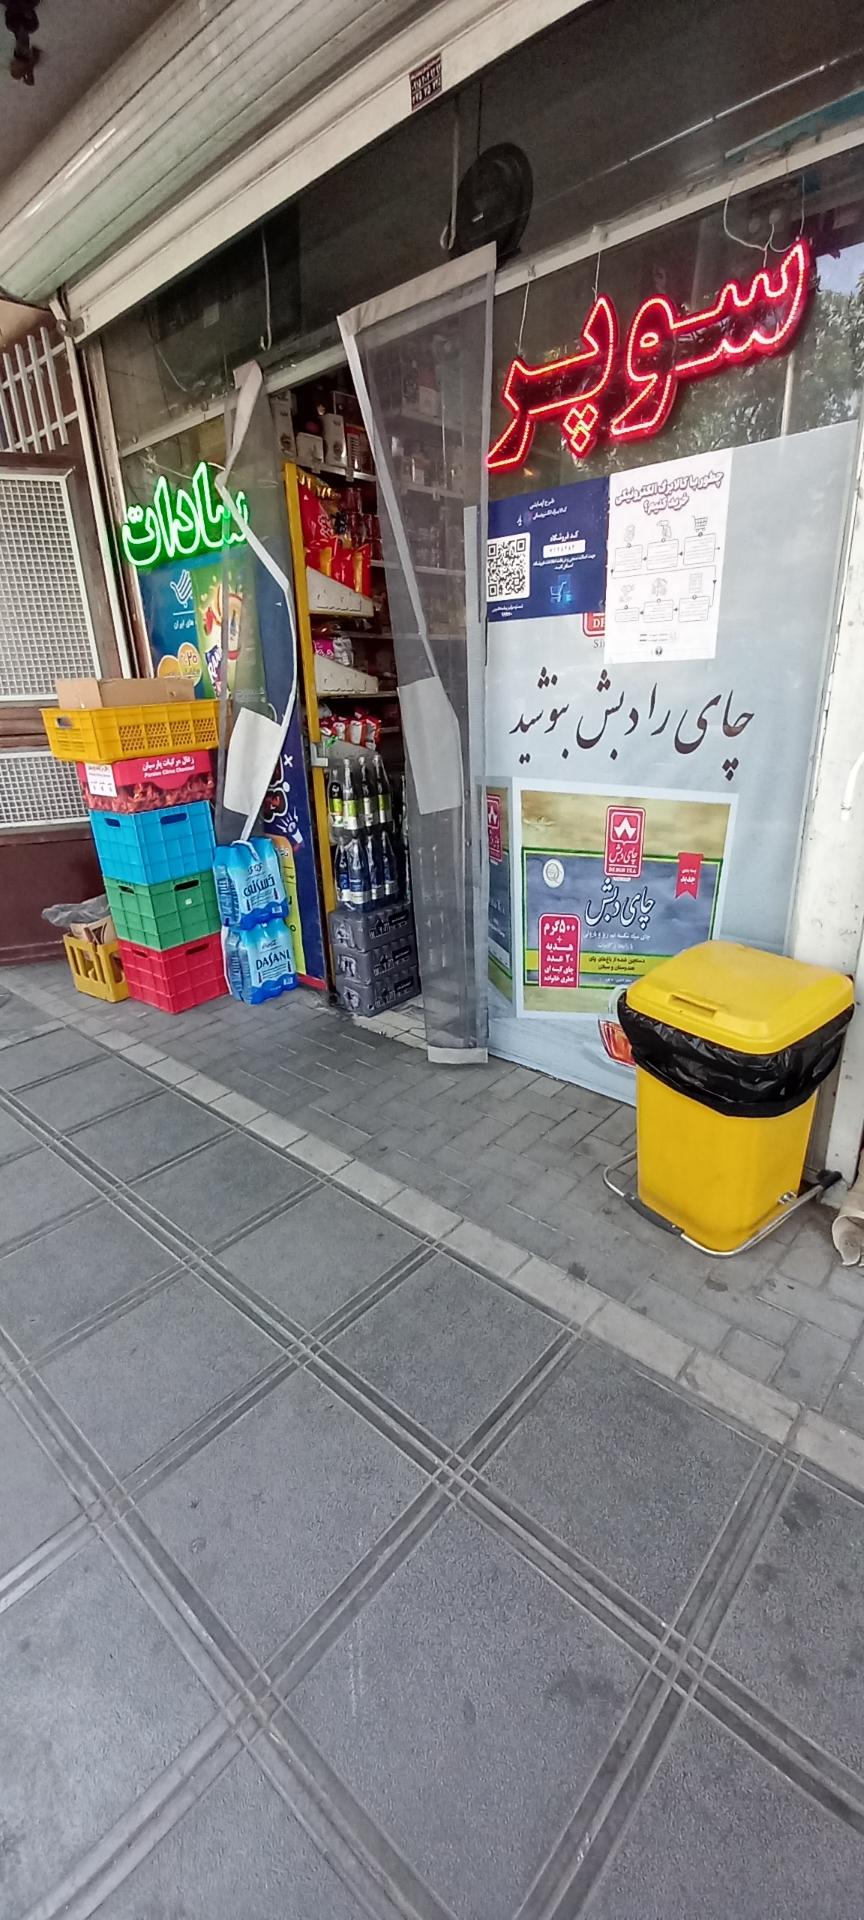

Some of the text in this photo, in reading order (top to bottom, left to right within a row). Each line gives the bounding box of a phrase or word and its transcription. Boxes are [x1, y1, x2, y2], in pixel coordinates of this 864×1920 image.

[488, 241, 806, 469] سوپر
[700, 470, 725, 490] چطور
[667, 492, 690, 511] خرید
[122, 461, 249, 566] سادات
[509, 667, 755, 781] چای را دبش بنوشید
[609, 844, 639, 865] چای دبش
[680, 876, 696, 885] جدید
[585, 877, 656, 930] چای دبش
[255, 949, 291, 971] DASANI
[546, 954, 564, 963] عدد
